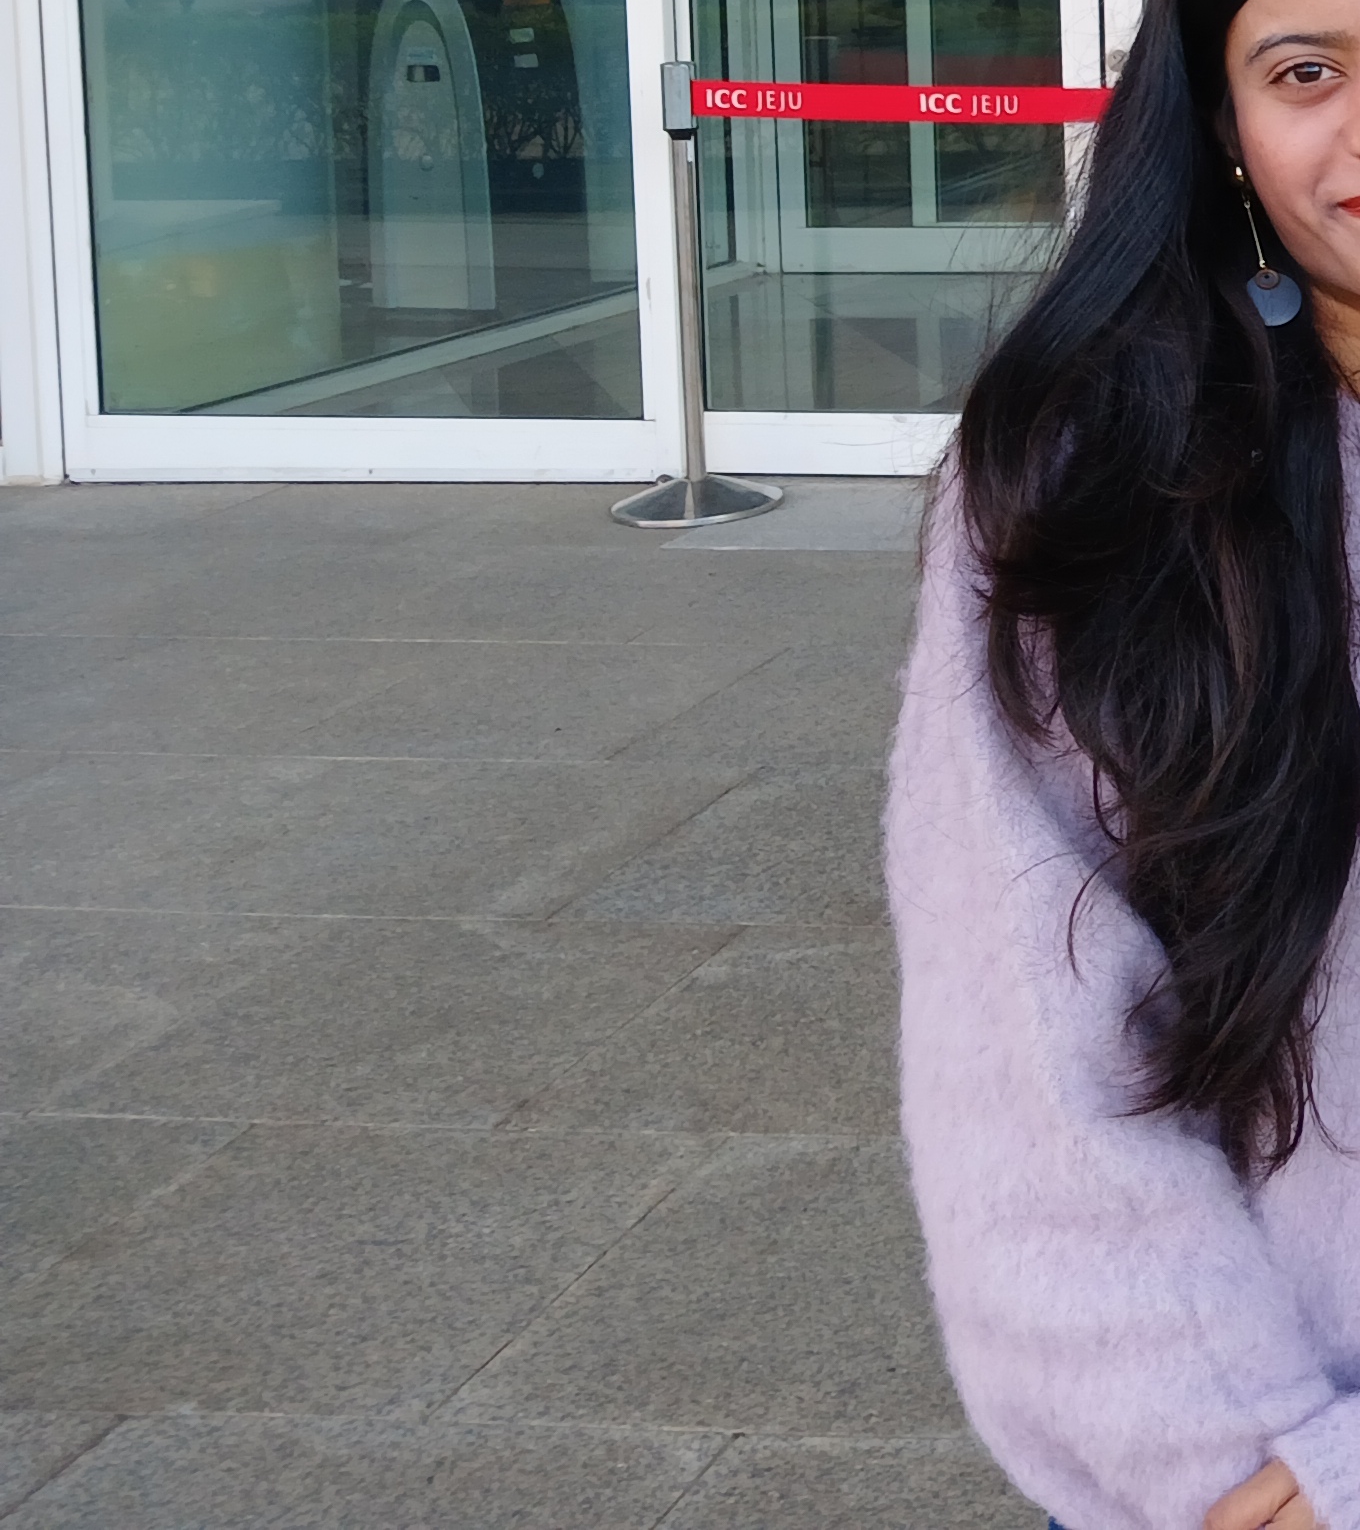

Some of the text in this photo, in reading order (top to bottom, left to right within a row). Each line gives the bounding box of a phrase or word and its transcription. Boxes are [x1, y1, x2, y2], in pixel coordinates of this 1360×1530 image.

[706, 88, 803, 112] ICC JEJU
[919, 92, 1020, 117] ICC JEJU
